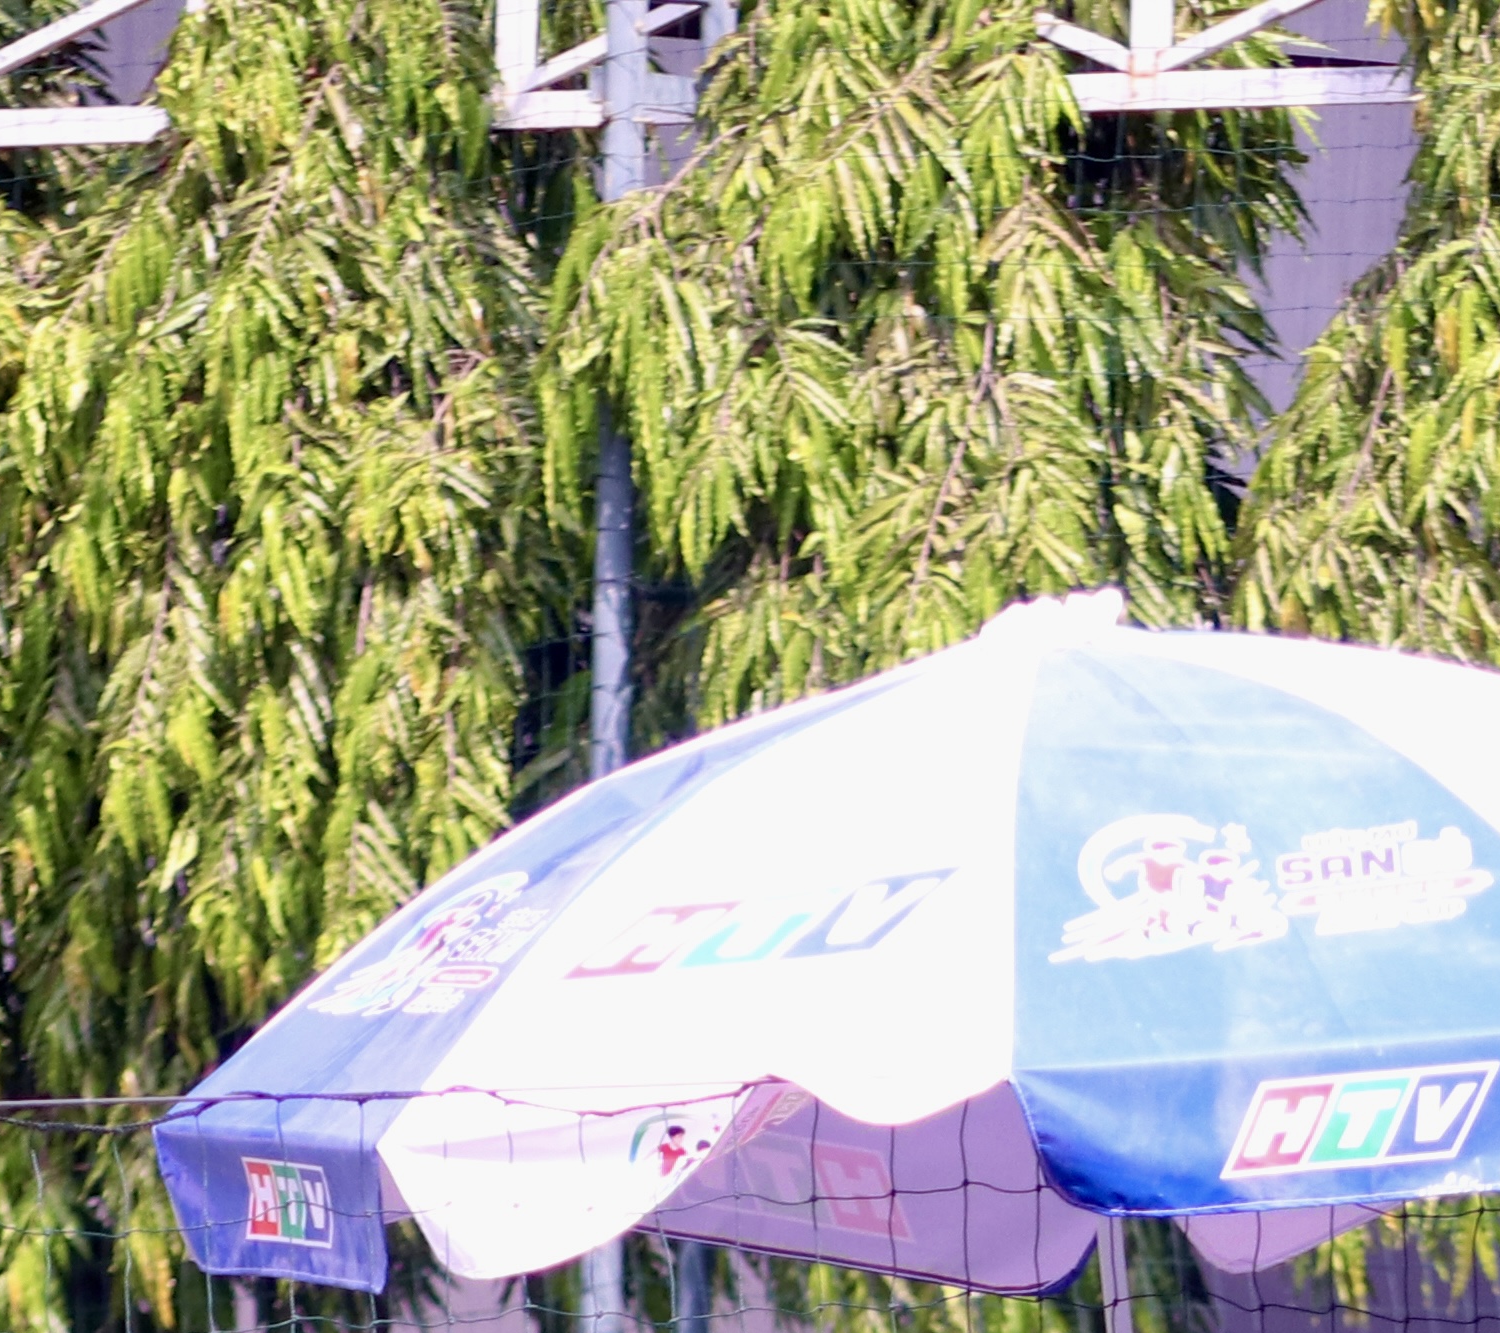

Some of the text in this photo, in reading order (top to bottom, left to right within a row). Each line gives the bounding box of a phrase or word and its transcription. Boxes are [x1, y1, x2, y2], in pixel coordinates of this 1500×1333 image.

[570, 868, 950, 977] HTV
[1242, 1081, 1479, 1159] HTV
[250, 1172, 324, 1229] HTV
